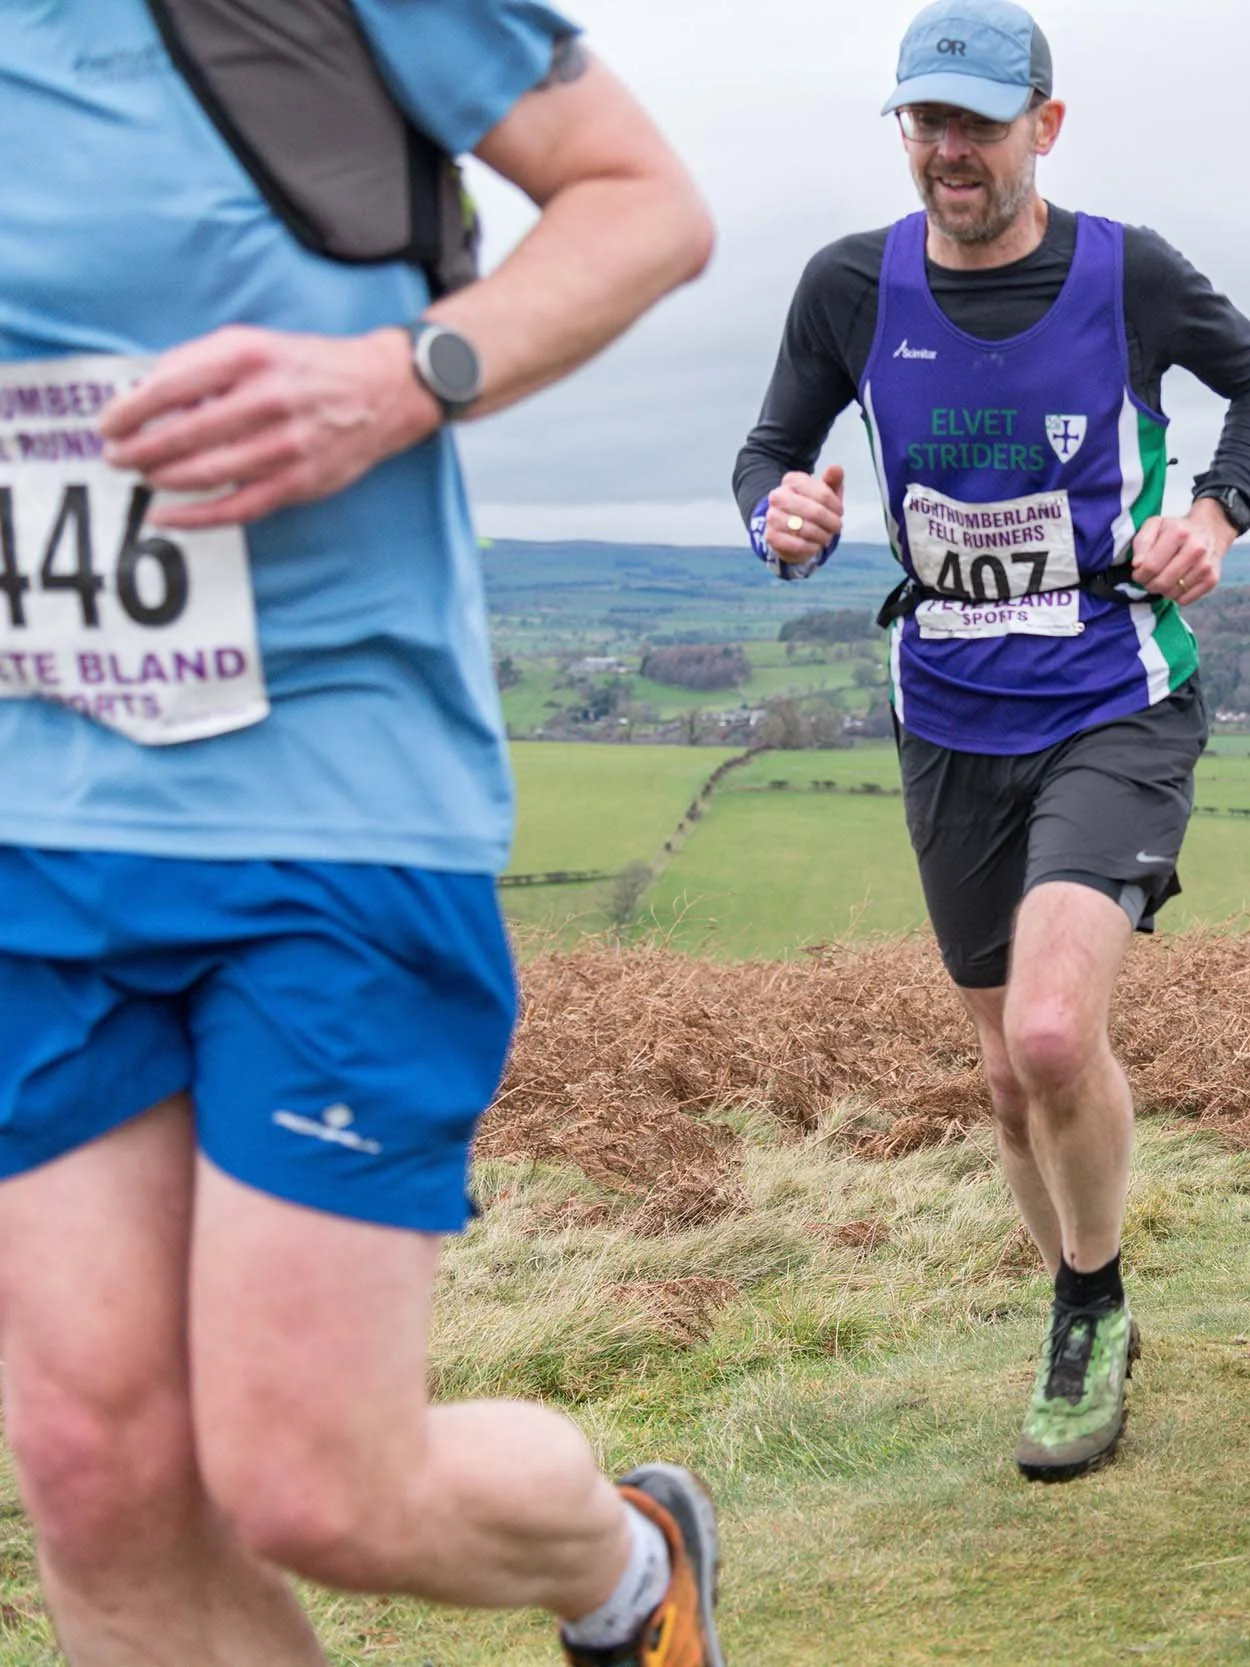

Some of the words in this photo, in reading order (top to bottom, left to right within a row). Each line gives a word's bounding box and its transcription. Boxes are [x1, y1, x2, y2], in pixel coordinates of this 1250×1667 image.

[936, 38, 966, 57] OR
[932, 408, 1018, 436] ELVET
[908, 442, 1046, 471] STRIDERS
[928, 520, 957, 545] FELL
[963, 525, 1045, 548] RUNNERS
[936, 550, 1049, 602] 407
[77, 647, 248, 686] BLAND
